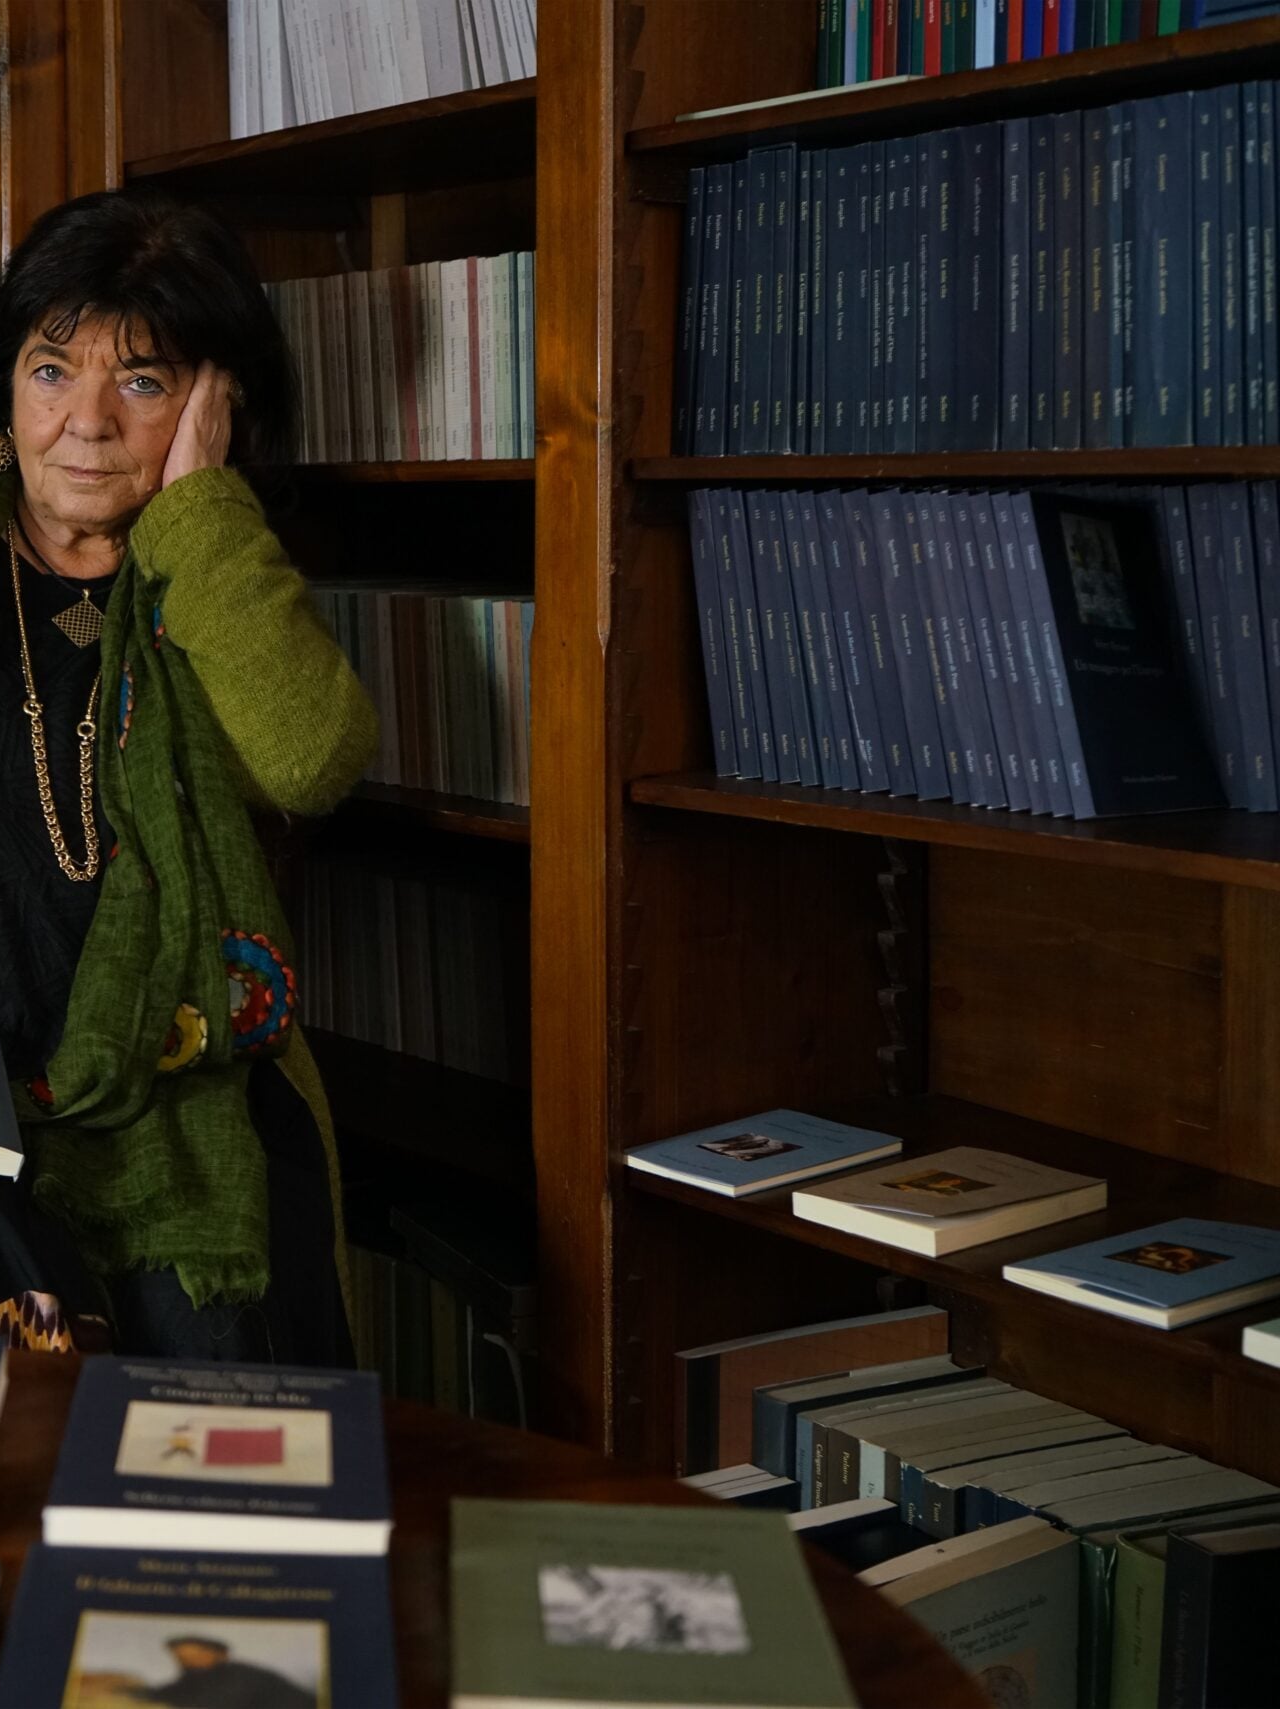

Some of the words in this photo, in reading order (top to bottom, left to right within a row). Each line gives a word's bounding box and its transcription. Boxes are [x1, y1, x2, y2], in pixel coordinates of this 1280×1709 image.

[1093, 392, 1101, 420] Sellerio
[1114, 388, 1122, 416] Sellerio
[800, 738, 808, 759] Sellerio
[1071, 762, 1082, 786] Sellerio
[842, 1451, 851, 1485] Parlatore
